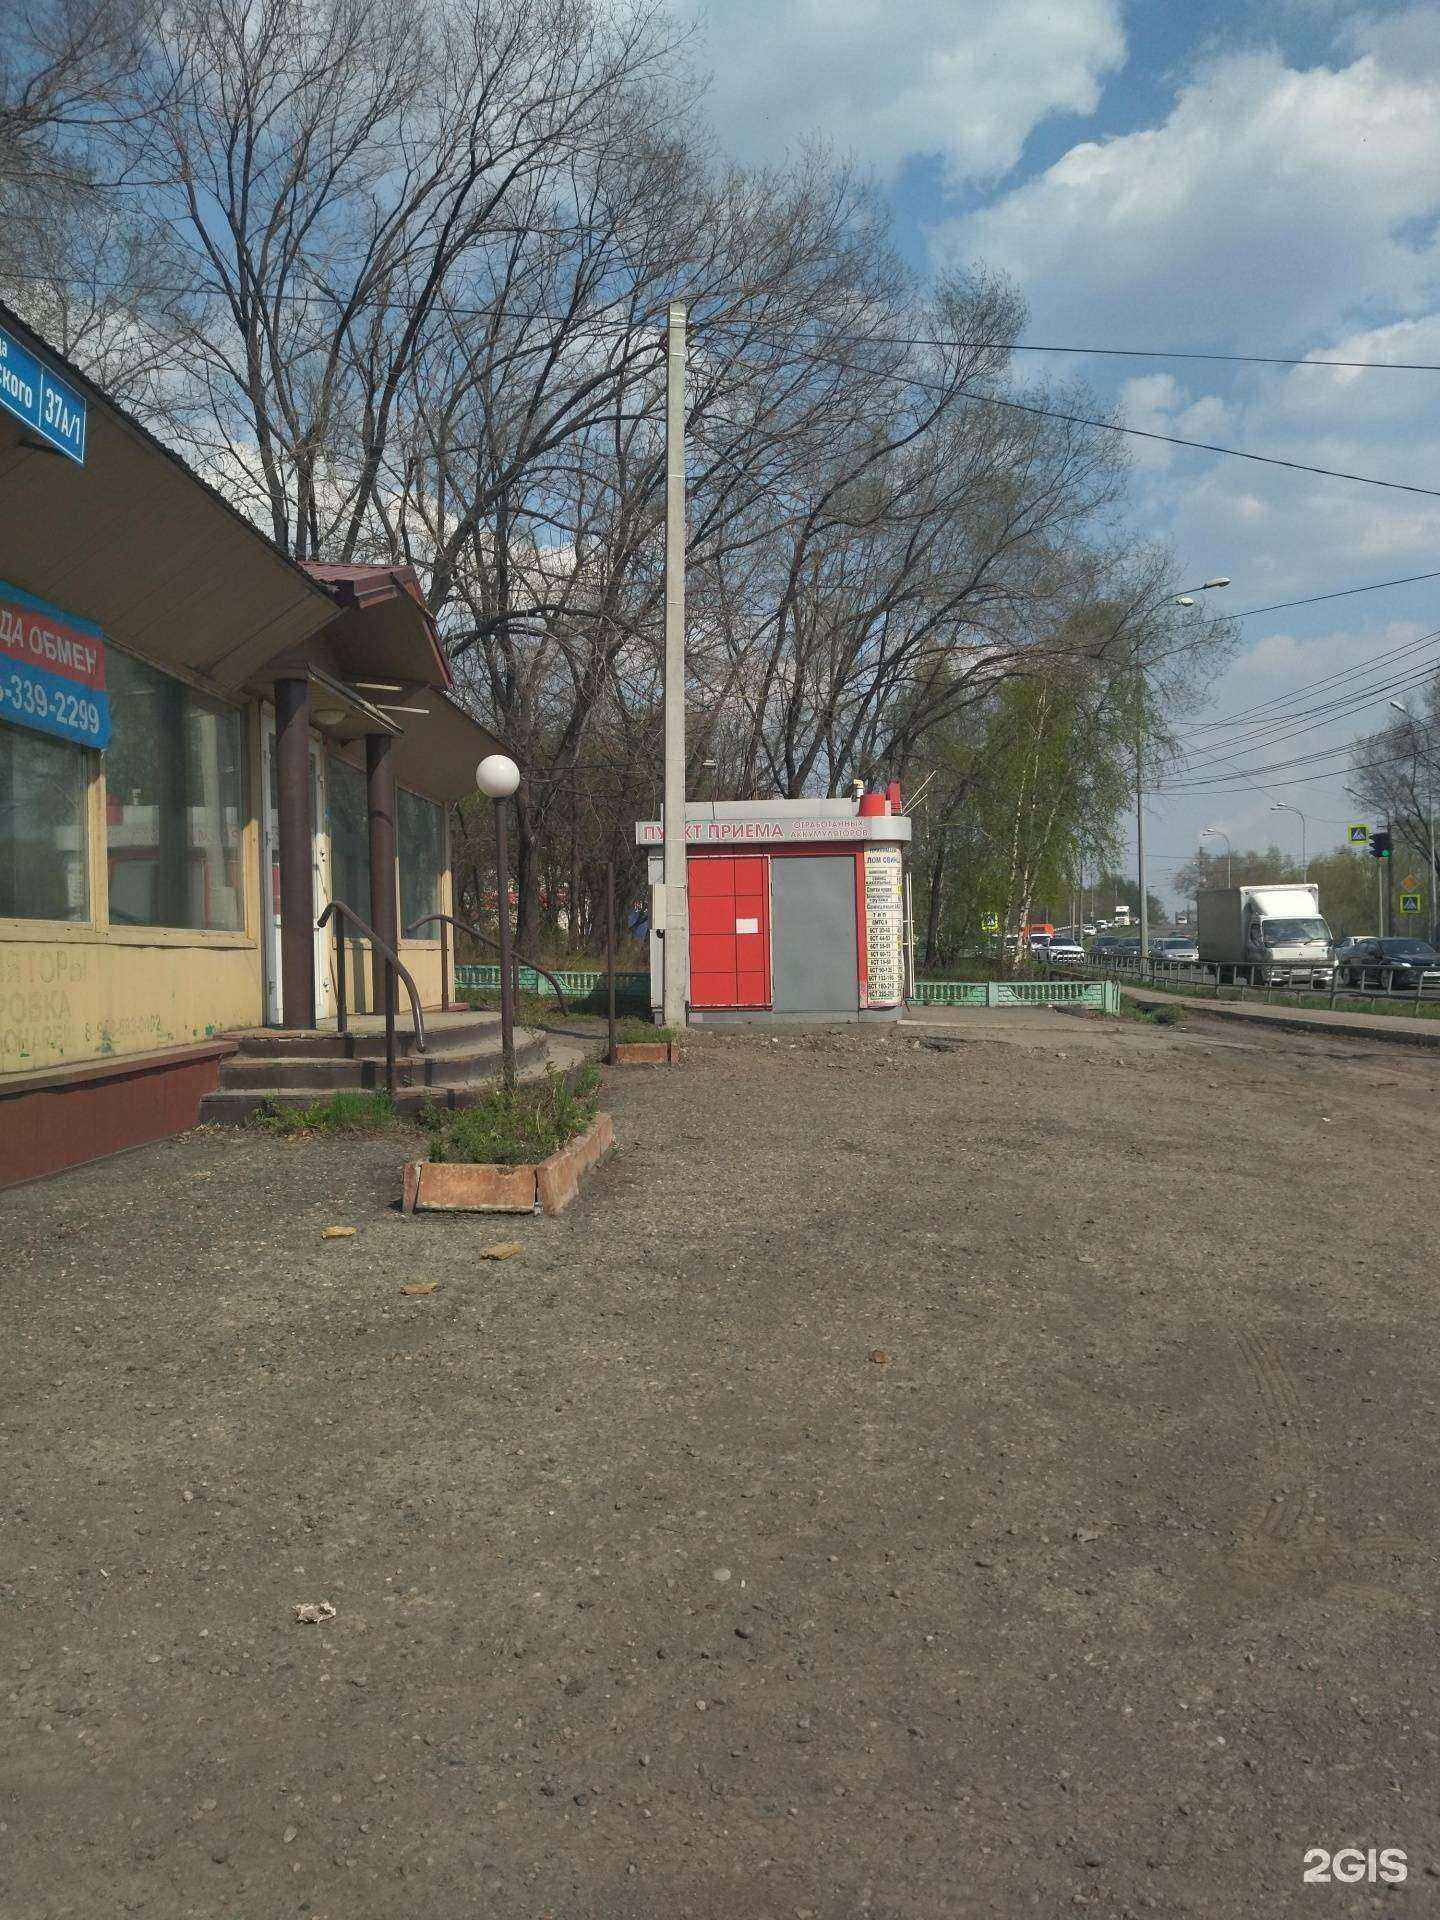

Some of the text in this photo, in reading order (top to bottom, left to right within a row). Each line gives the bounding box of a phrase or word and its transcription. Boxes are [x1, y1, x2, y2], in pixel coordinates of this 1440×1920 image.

[45, 387, 81, 445] 37А/1
[29, 625, 97, 674] ОБМЕН
[643, 823, 785, 840] ПУКТ ПРИЕМА
